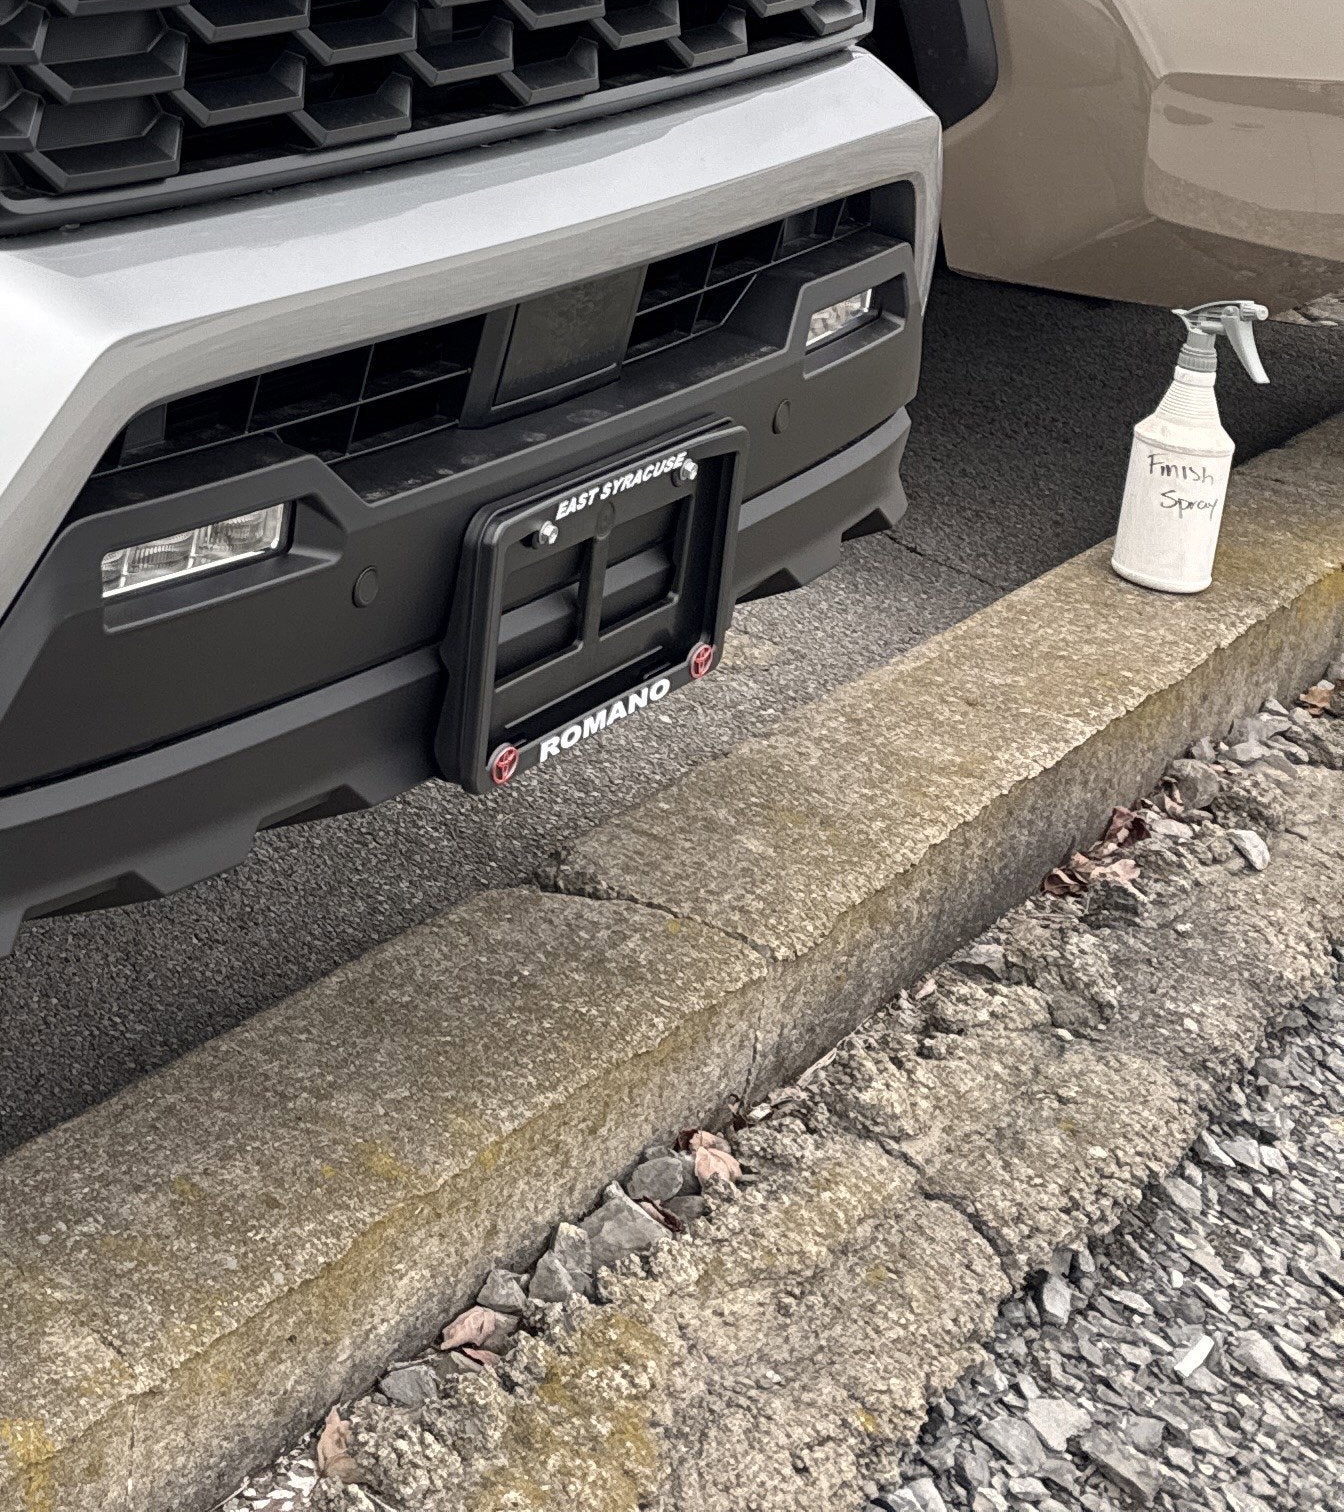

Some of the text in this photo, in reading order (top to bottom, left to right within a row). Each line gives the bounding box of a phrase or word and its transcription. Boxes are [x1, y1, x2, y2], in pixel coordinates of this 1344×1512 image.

[555, 450, 688, 522] EAST SYRACUSE
[1159, 489, 1219, 521] Spray
[539, 677, 671, 763] ROMANO
